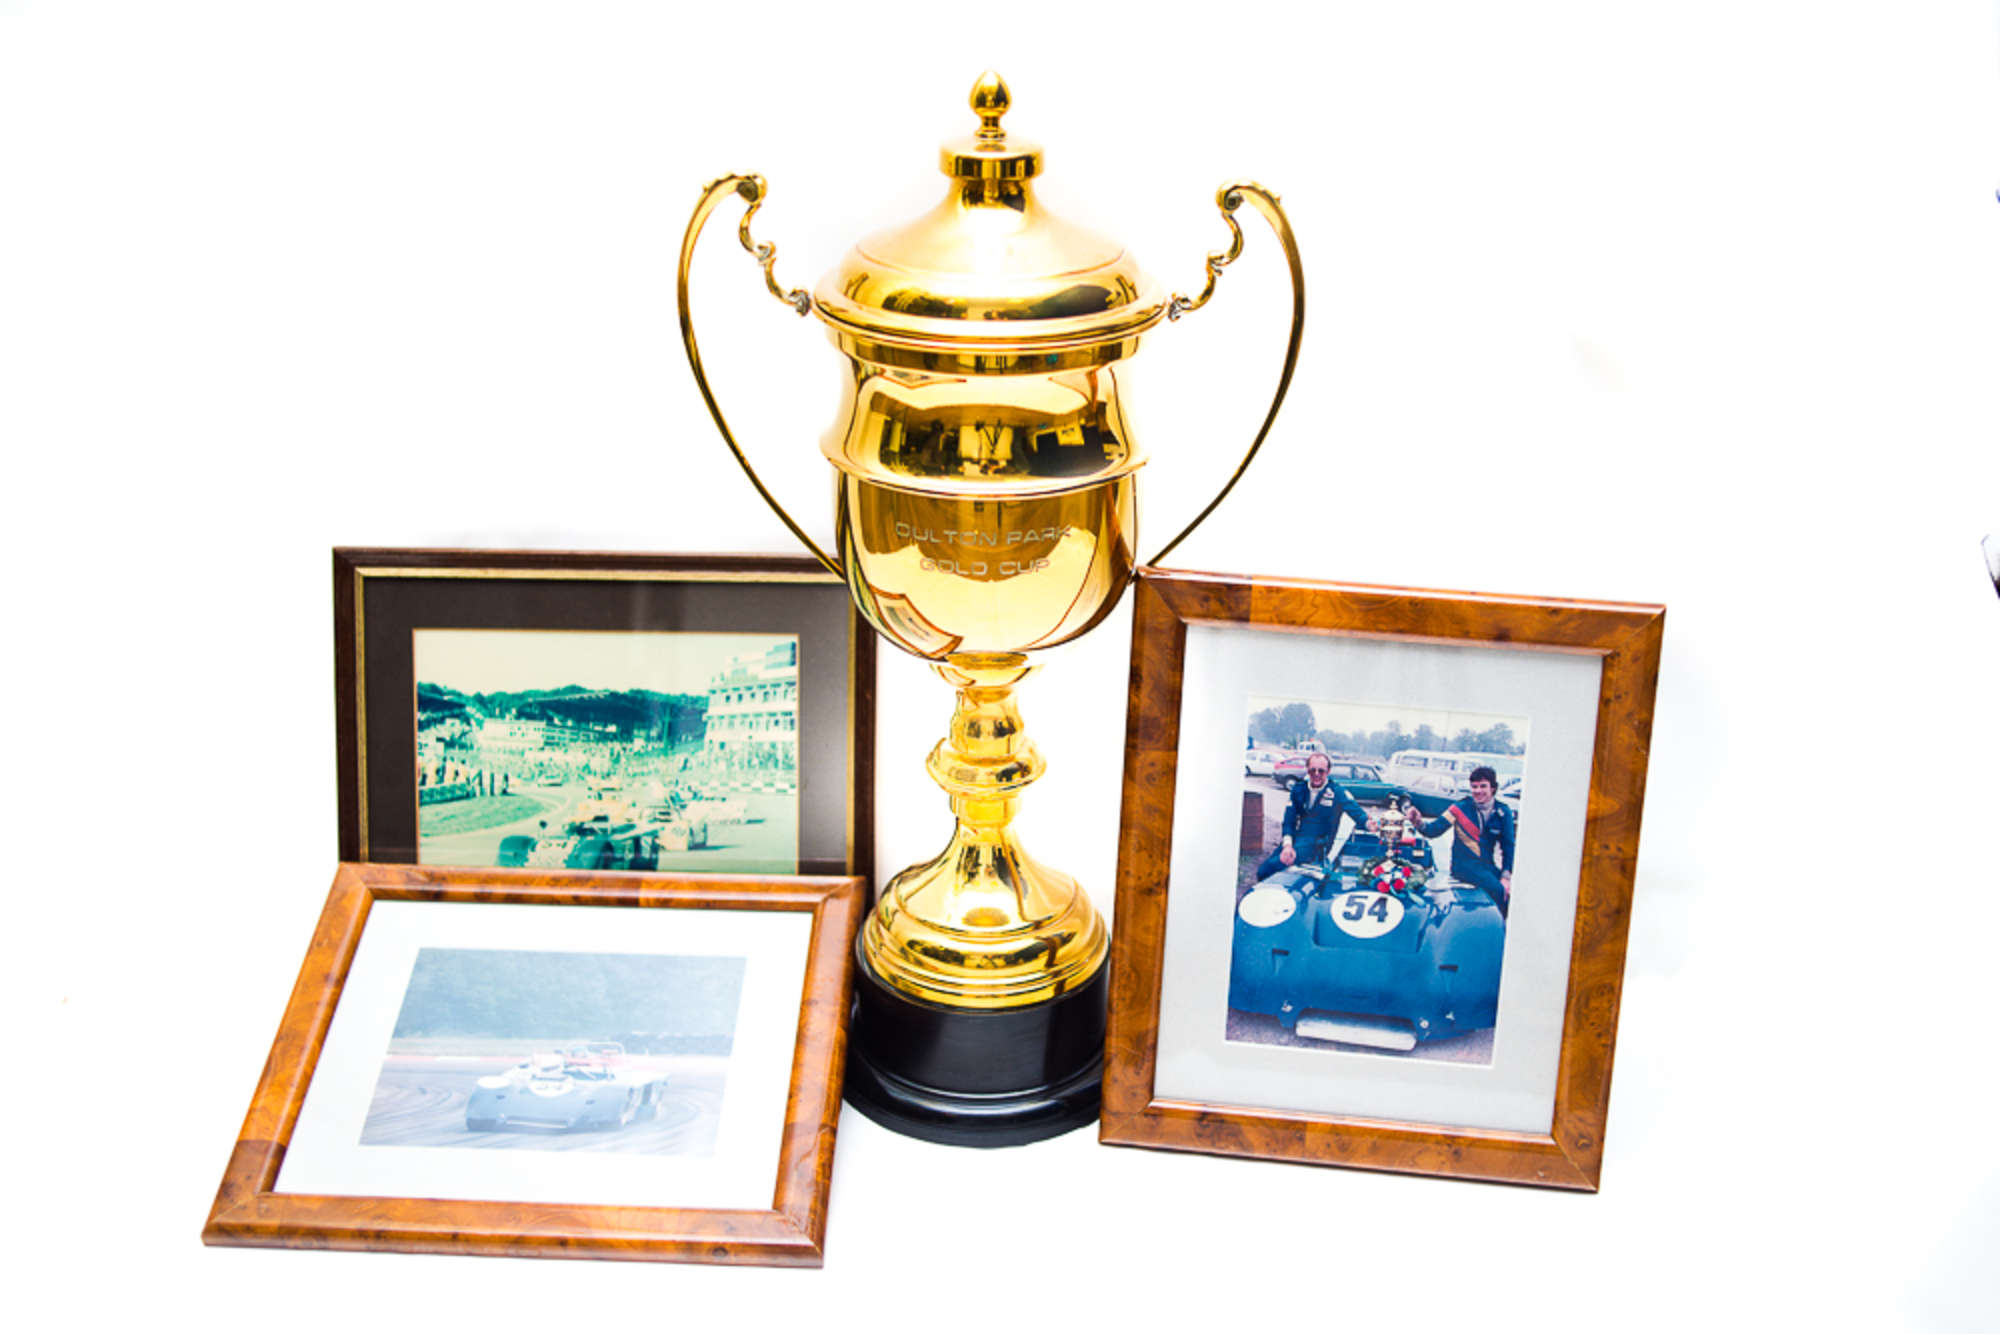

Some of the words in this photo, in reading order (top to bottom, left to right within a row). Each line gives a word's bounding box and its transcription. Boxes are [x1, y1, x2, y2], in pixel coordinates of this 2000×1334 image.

[1006, 524, 1072, 544] PARK
[920, 557, 988, 576] GOLD
[1000, 558, 1050, 576] CUP
[1342, 894, 1389, 923] 54
